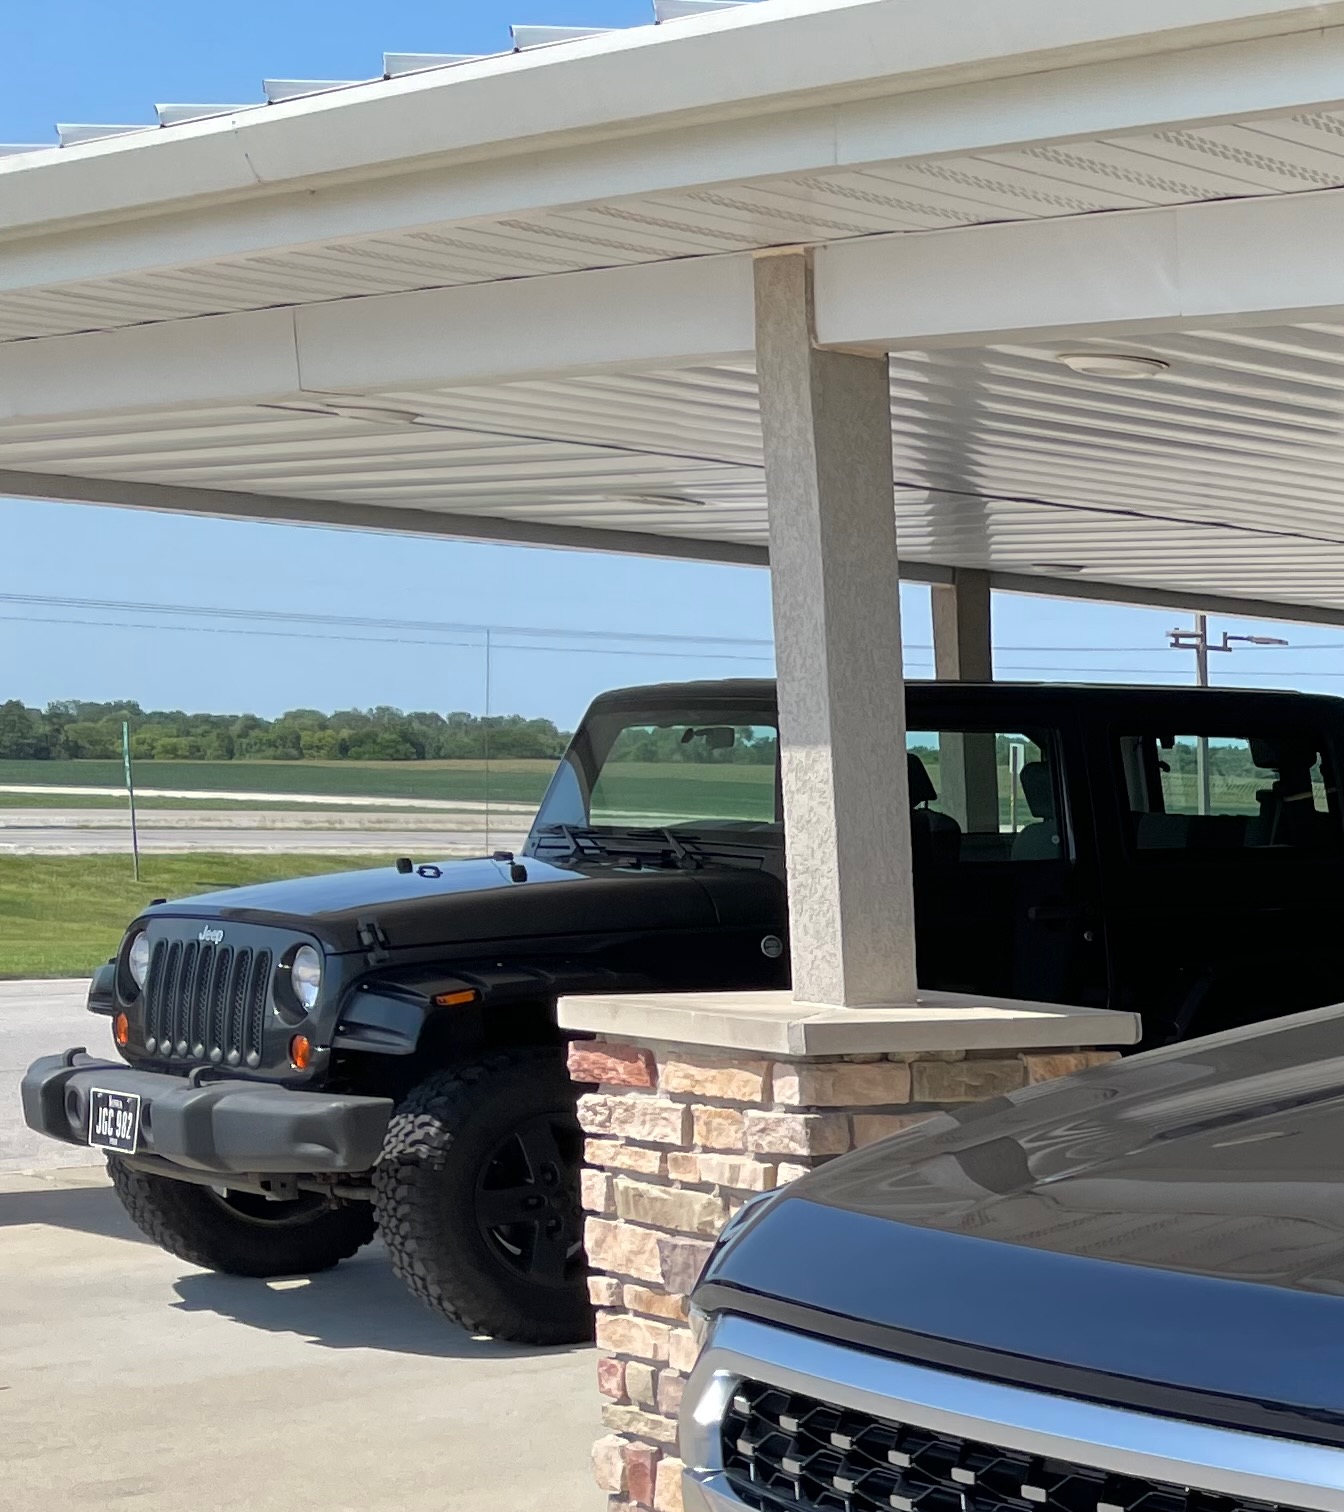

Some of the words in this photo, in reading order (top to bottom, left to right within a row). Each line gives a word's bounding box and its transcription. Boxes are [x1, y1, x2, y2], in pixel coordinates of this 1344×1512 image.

[198, 925, 224, 945] Jeep
[95, 1106, 114, 1137] JGC
[115, 1110, 133, 1140] 982
